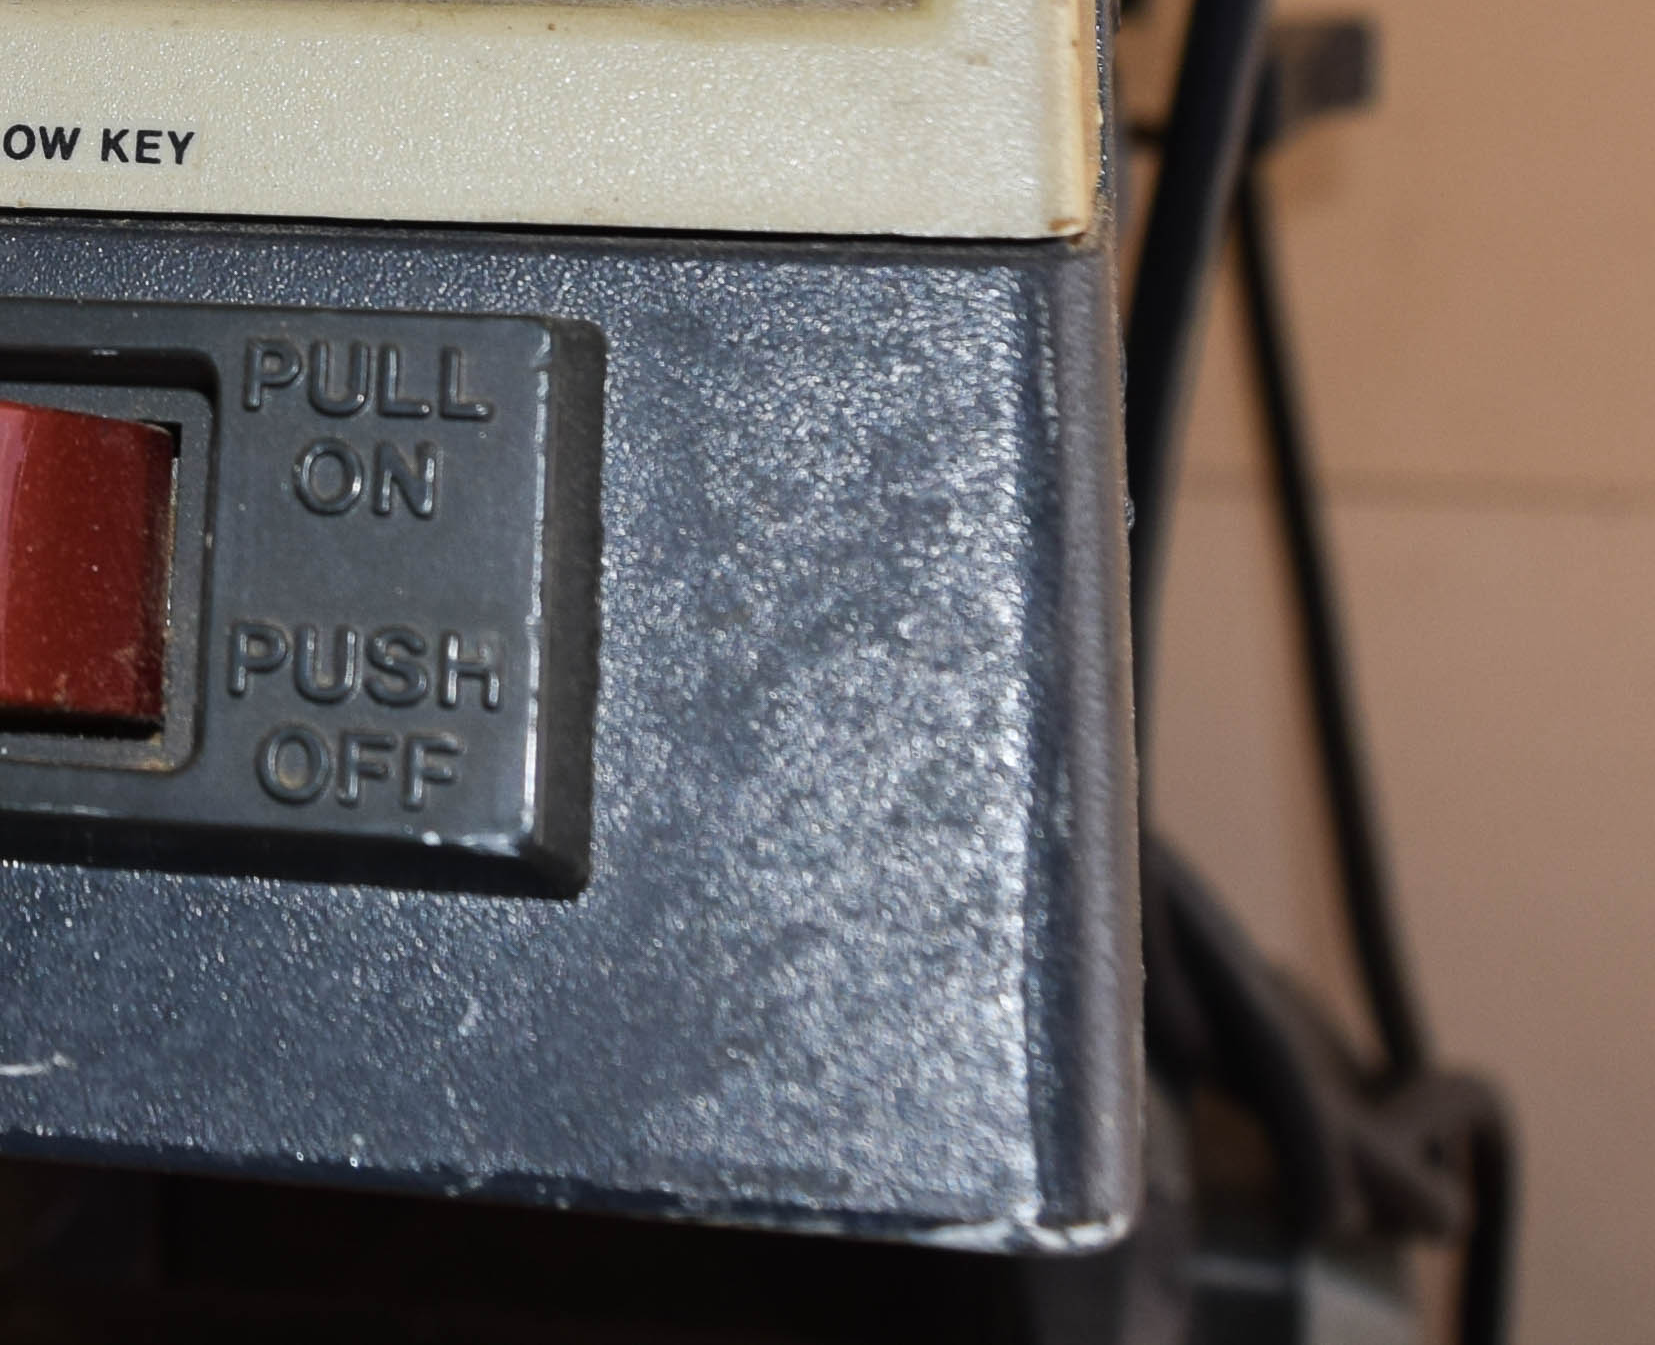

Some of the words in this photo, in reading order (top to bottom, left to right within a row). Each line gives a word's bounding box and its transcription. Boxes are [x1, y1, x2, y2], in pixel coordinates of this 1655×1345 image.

[100, 129, 196, 166] KEY
[244, 339, 494, 422] PULL
[293, 436, 439, 520] ON
[228, 621, 502, 713] PUSH
[255, 722, 463, 810] OFF
